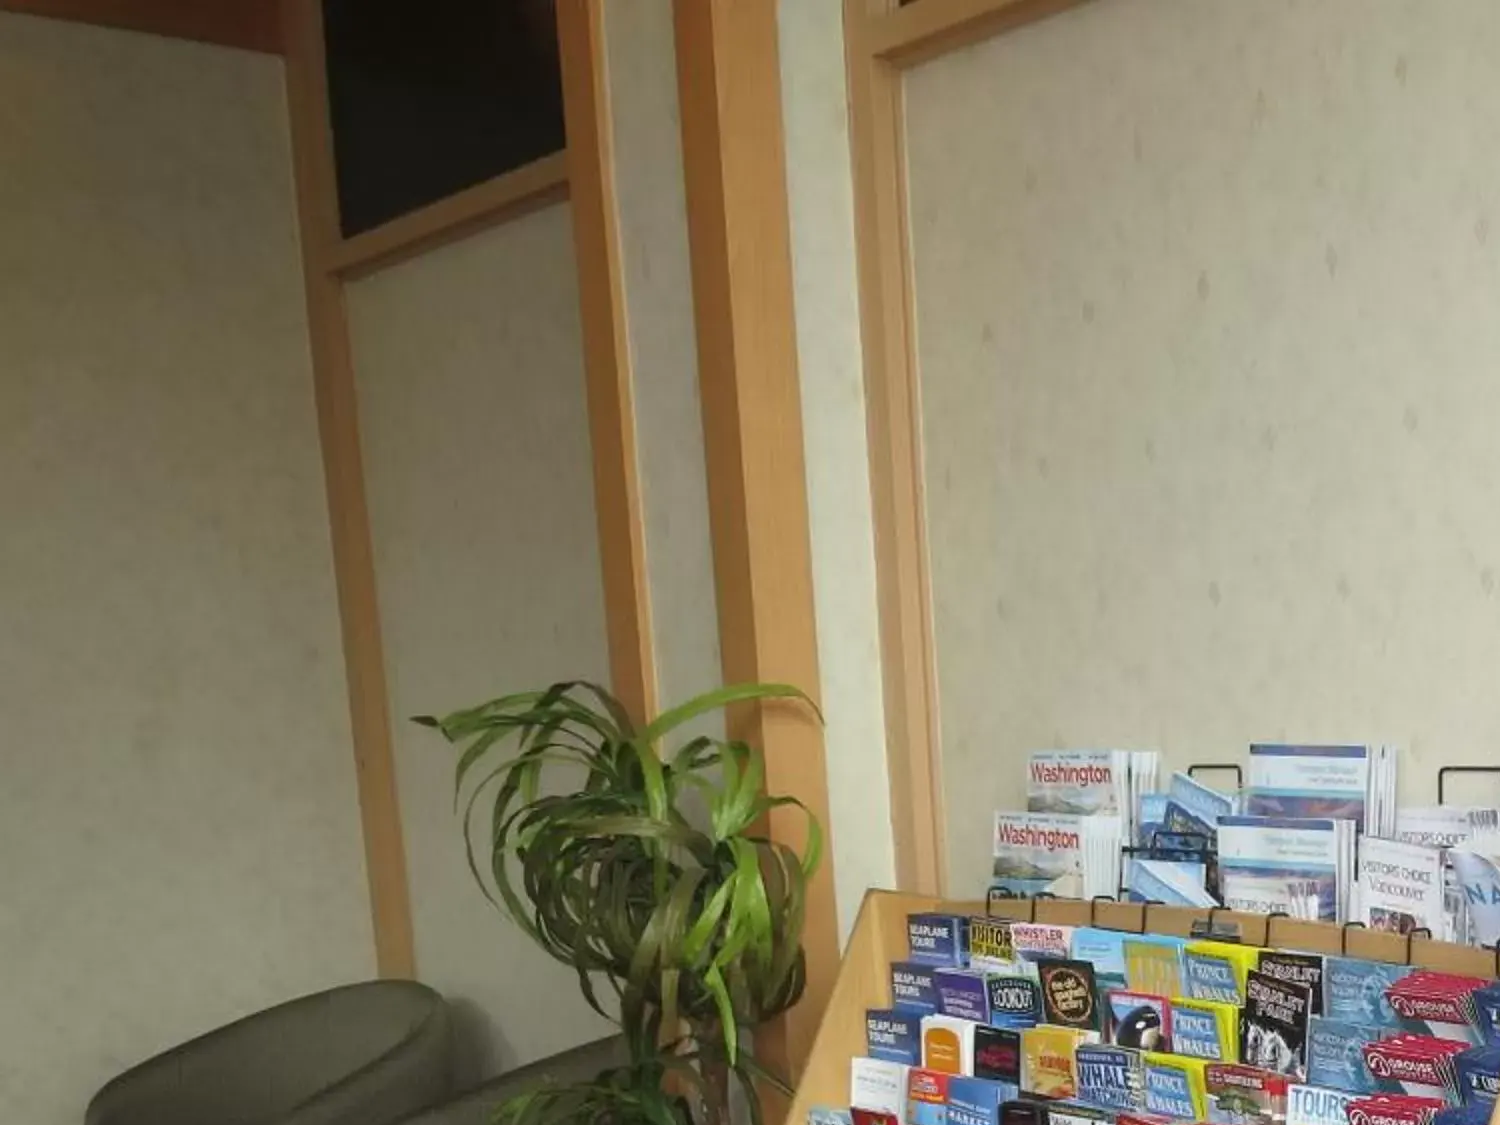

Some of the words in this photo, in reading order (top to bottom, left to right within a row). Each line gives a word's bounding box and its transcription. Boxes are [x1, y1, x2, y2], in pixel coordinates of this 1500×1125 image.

[1030, 762, 1112, 787] Washington
[998, 823, 1080, 850] Washington
[1013, 927, 1064, 941] WHISTLER
[992, 987, 1034, 1012] LOOKOUT
[1079, 1062, 1128, 1088] WHALE
